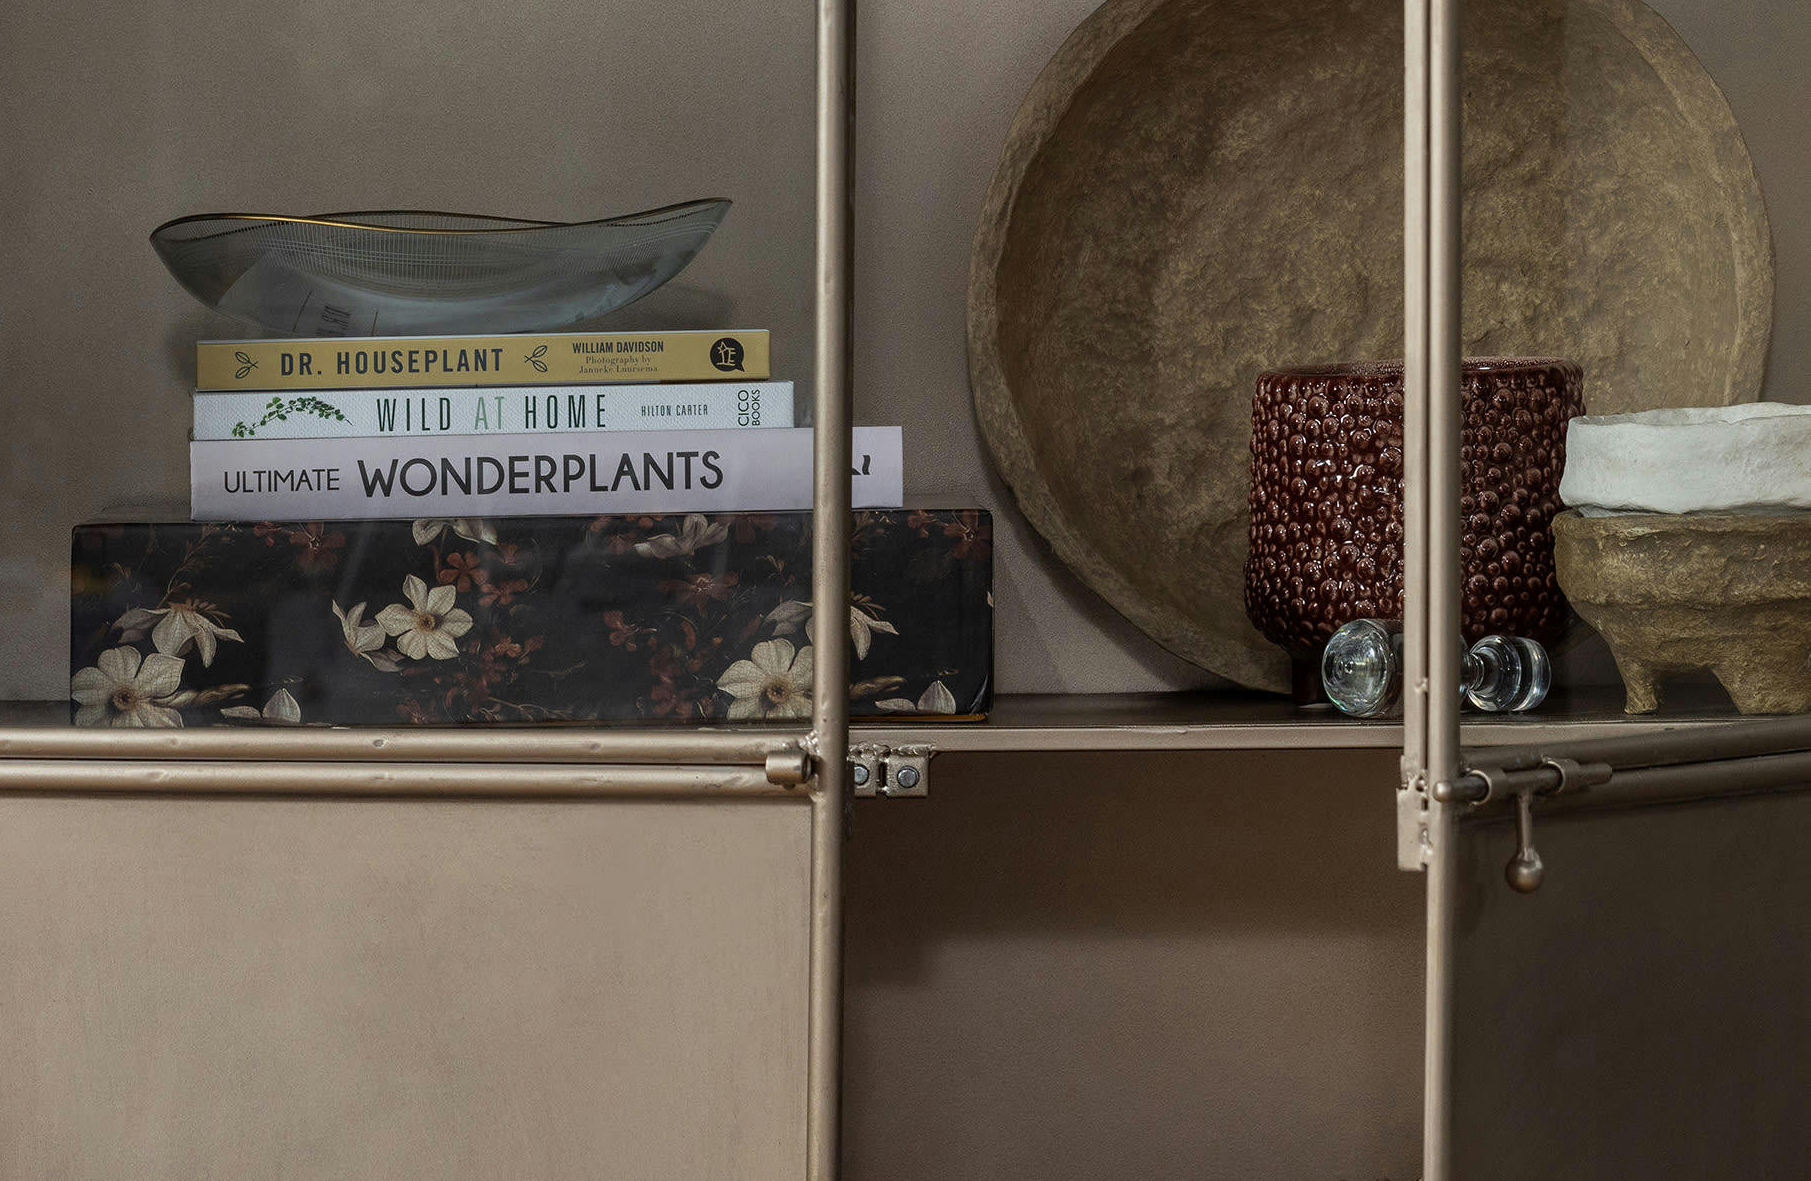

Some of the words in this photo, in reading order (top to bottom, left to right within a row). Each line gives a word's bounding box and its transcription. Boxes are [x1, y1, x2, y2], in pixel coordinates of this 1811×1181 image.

[573, 342, 614, 354] WILLIAM
[617, 341, 664, 353] DAVIDSON
[586, 356, 639, 366] Photography
[641, 356, 651, 365] by
[281, 352, 322, 376] DR.
[337, 348, 503, 375] HOUSEPLANT
[579, 365, 614, 374] Janneke
[377, 397, 451, 432] WILD
[475, 396, 504, 430] AT
[525, 394, 606, 429] HOME
[641, 405, 671, 417] HILTON
[676, 404, 708, 416] CARTER
[737, 389, 750, 427] CICO
[751, 388, 761, 426] BOOKS
[225, 468, 340, 494] ULTIMATE
[357, 450, 724, 498] WONDERPLANTS
